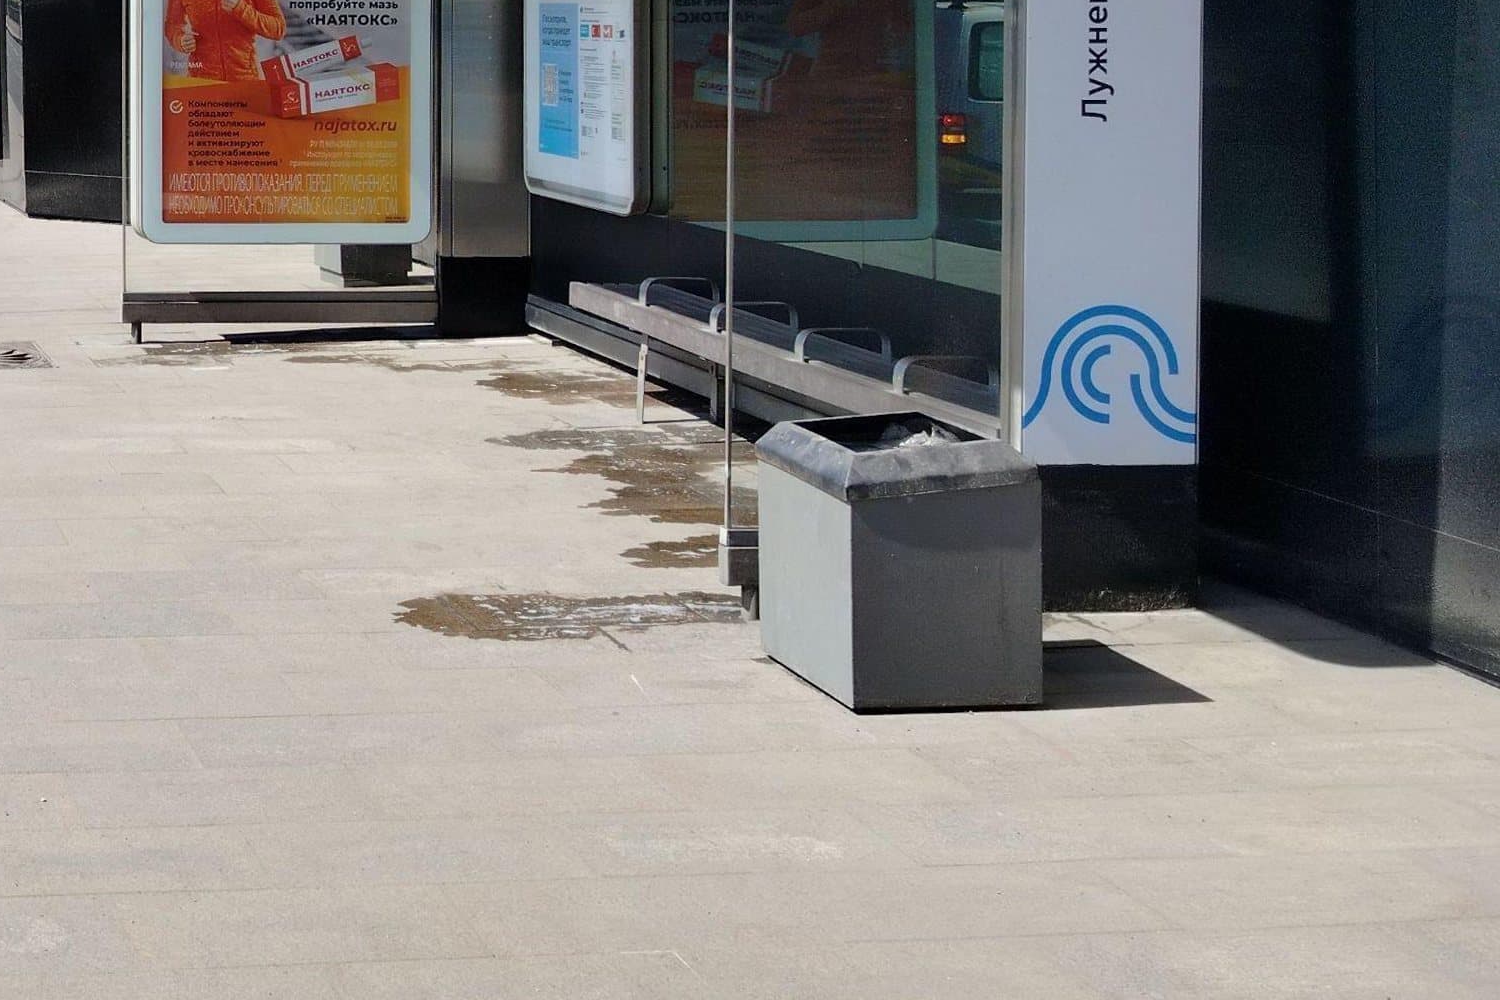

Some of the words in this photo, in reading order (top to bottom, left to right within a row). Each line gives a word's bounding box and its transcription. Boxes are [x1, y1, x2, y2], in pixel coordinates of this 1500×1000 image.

[289, 0, 366, 11] попробуйте
[369, 0, 399, 9] мазь
[306, 14, 398, 26] «НАЯТОКС»
[293, 48, 339, 69] НАЯТОКС
[315, 83, 371, 98] НАЯТОКС
[188, 100, 248, 108] Компоненты
[188, 110, 234, 118] обладают
[188, 120, 266, 128] болеутоляющим
[313, 118, 398, 134] najatox.ru
[188, 130, 240, 138] действием
[196, 140, 264, 148] активизируют
[188, 149, 271, 157] кровоснабжение
[169, 173, 211, 192] ИМЕЮТСЯ
